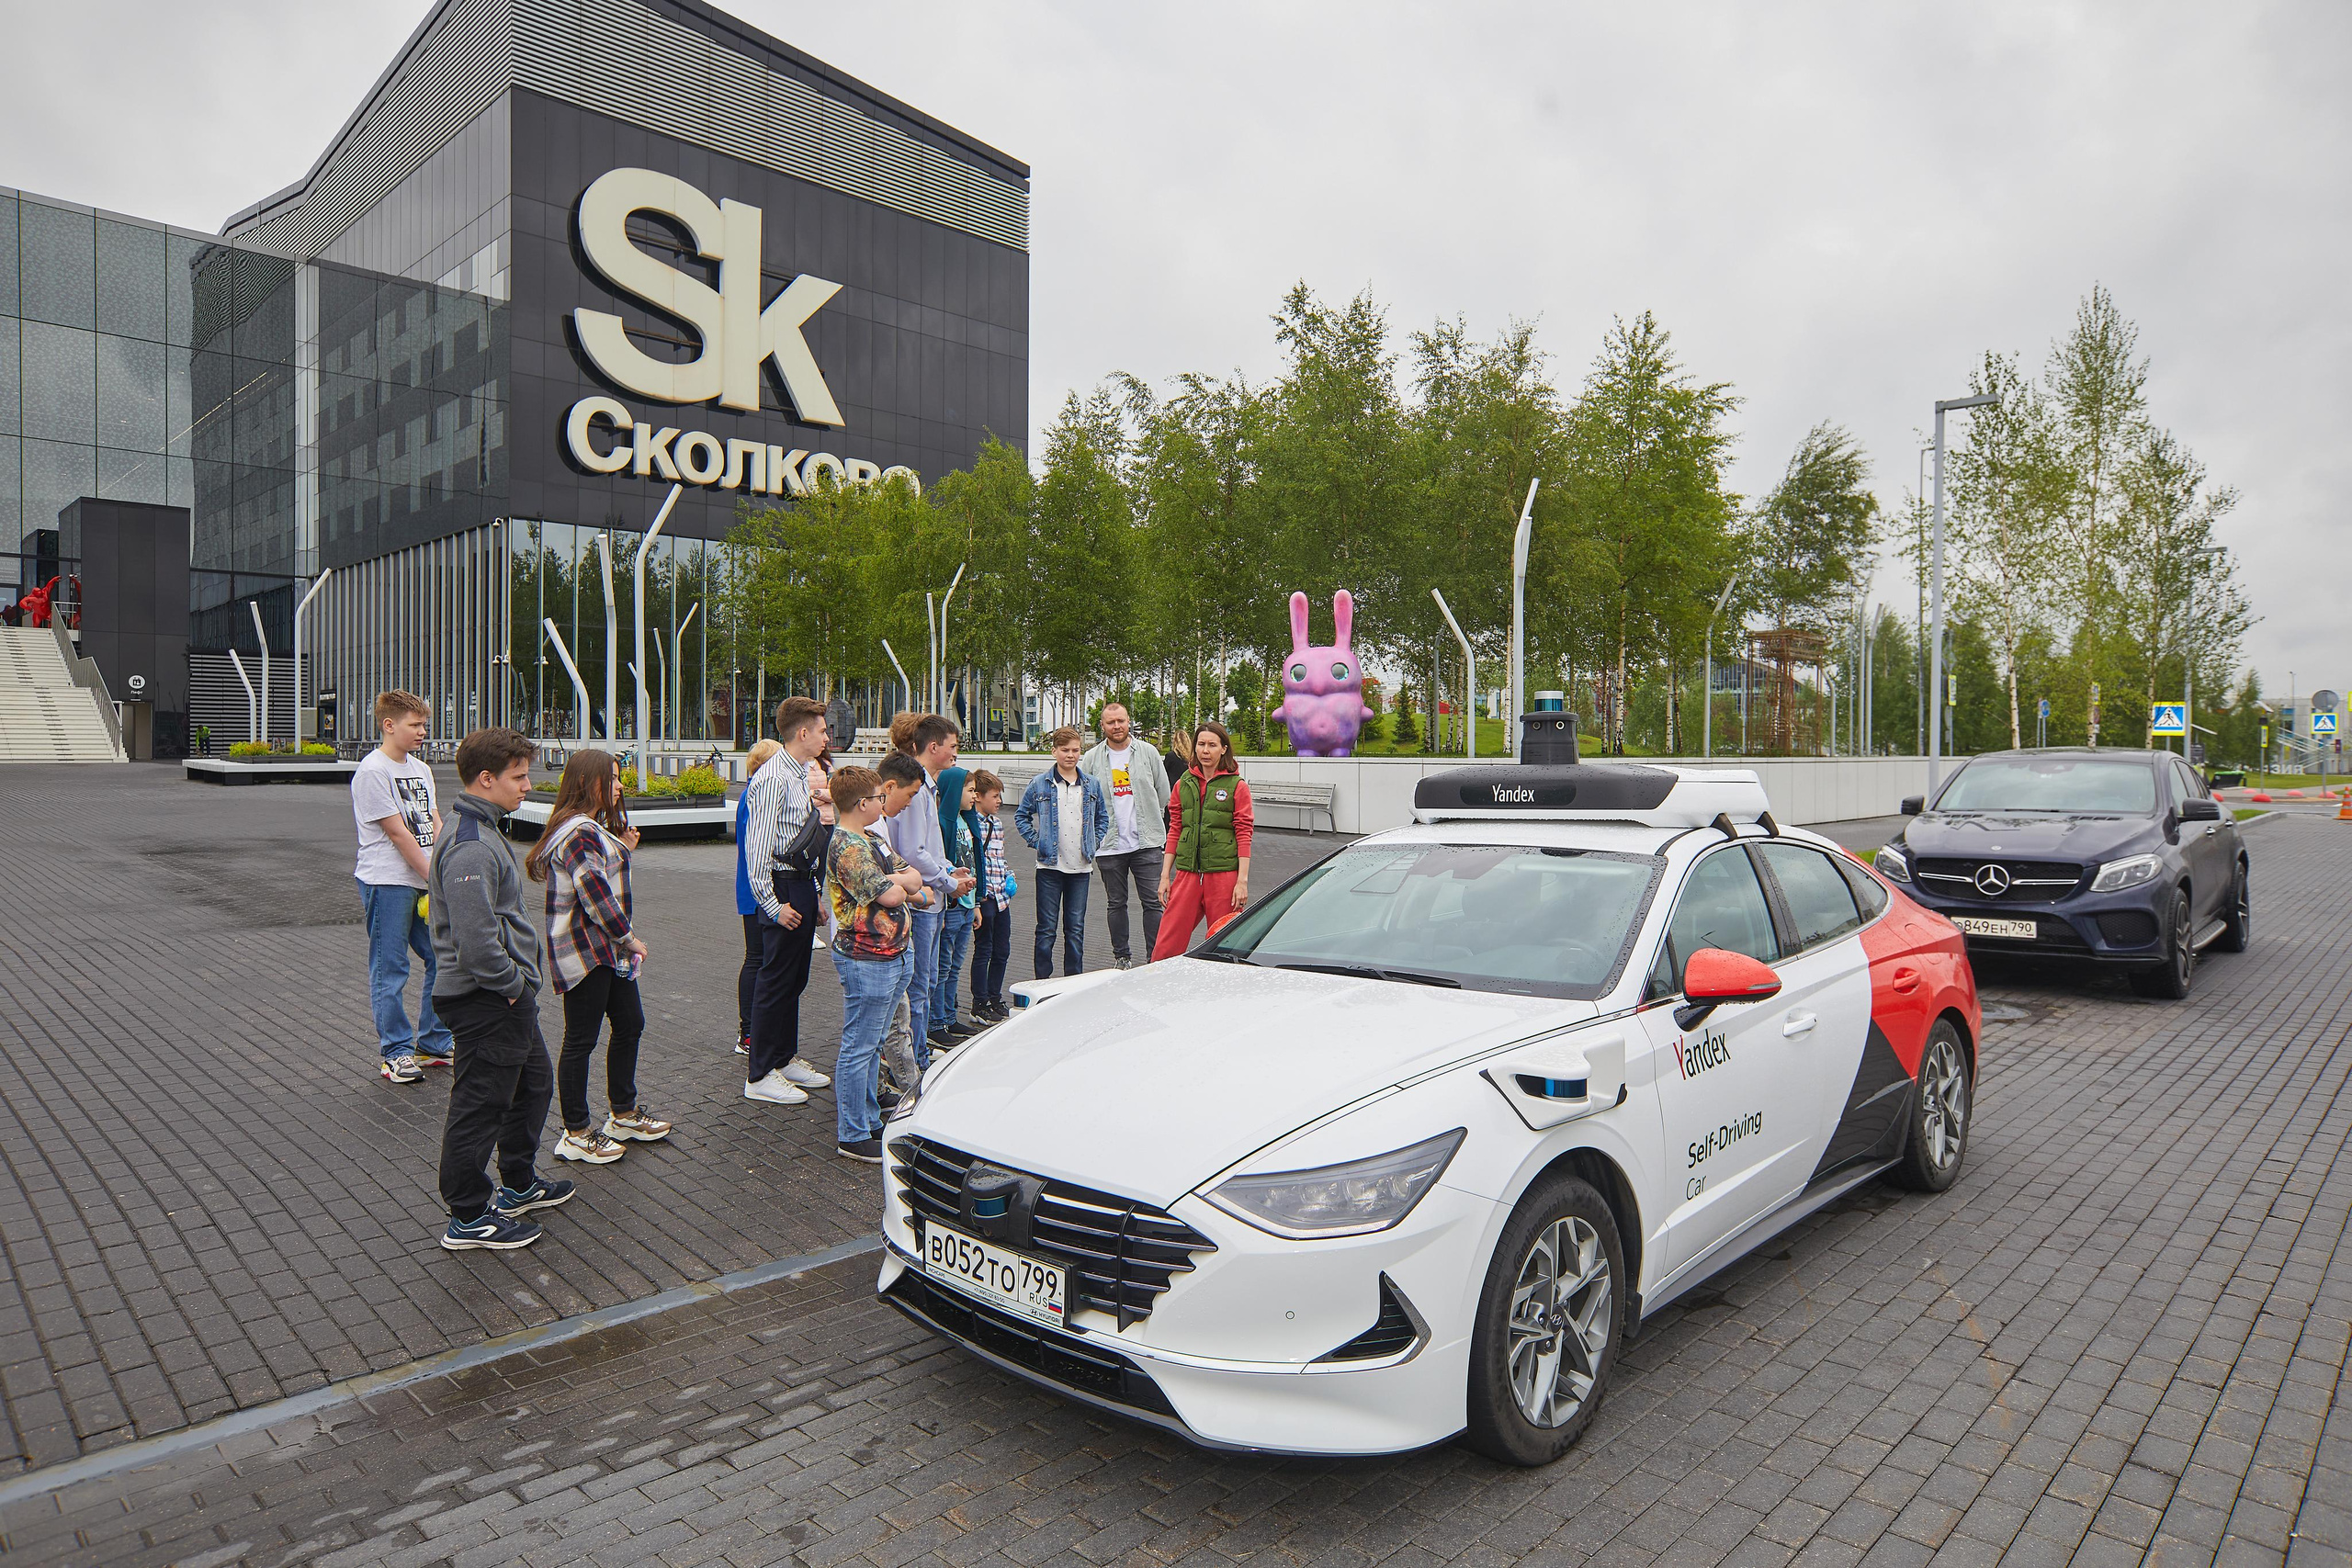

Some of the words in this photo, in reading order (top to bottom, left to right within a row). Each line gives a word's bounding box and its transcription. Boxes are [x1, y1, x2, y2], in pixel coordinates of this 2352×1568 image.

[574, 167, 846, 427] Sk
[416, 790, 428, 801] BE
[1491, 783, 1535, 802] Yandex
[2010, 921, 2032, 932] 790
[1673, 1029, 1731, 1080] Yandex
[1688, 1111, 1763, 1169] Self-Driving
[1686, 1174, 1707, 1201] Car
[1029, 1292, 1047, 1308] RUS
